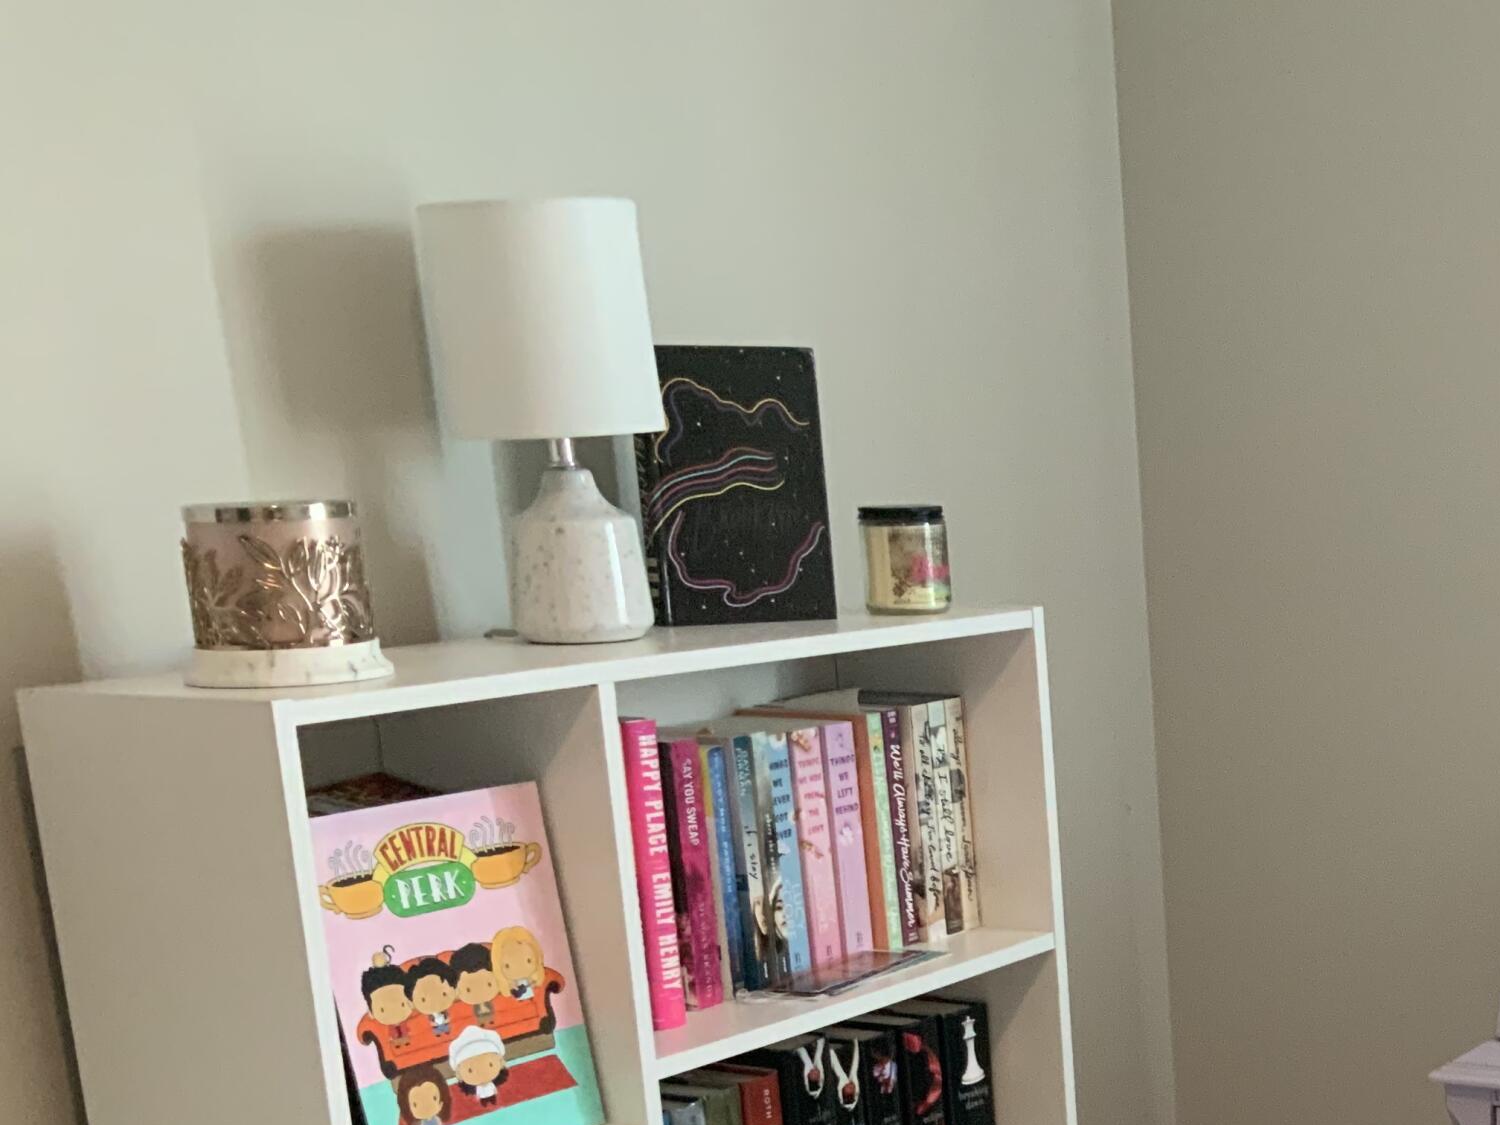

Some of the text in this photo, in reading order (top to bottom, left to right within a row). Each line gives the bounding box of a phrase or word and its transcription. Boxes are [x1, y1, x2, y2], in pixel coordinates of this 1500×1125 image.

[830, 753, 855, 766] THINGS
[838, 771, 849, 782] WE
[638, 734, 669, 857] HAPPY PLACE
[683, 782, 695, 805] YOU
[774, 793, 791, 806] EVER
[835, 802, 859, 815] BEHIND
[836, 787, 854, 799] LEFT
[893, 783, 908, 835] Always
[379, 825, 458, 872] CENTRAL
[777, 828, 792, 839] VER
[944, 827, 955, 862] love
[748, 853, 759, 880] stay
[896, 835, 911, 872] Have
[395, 868, 466, 910] PERK
[900, 869, 916, 927] Summer
[652, 872, 683, 990] EMILY HENRY
[763, 1088, 773, 1119] ROTH
